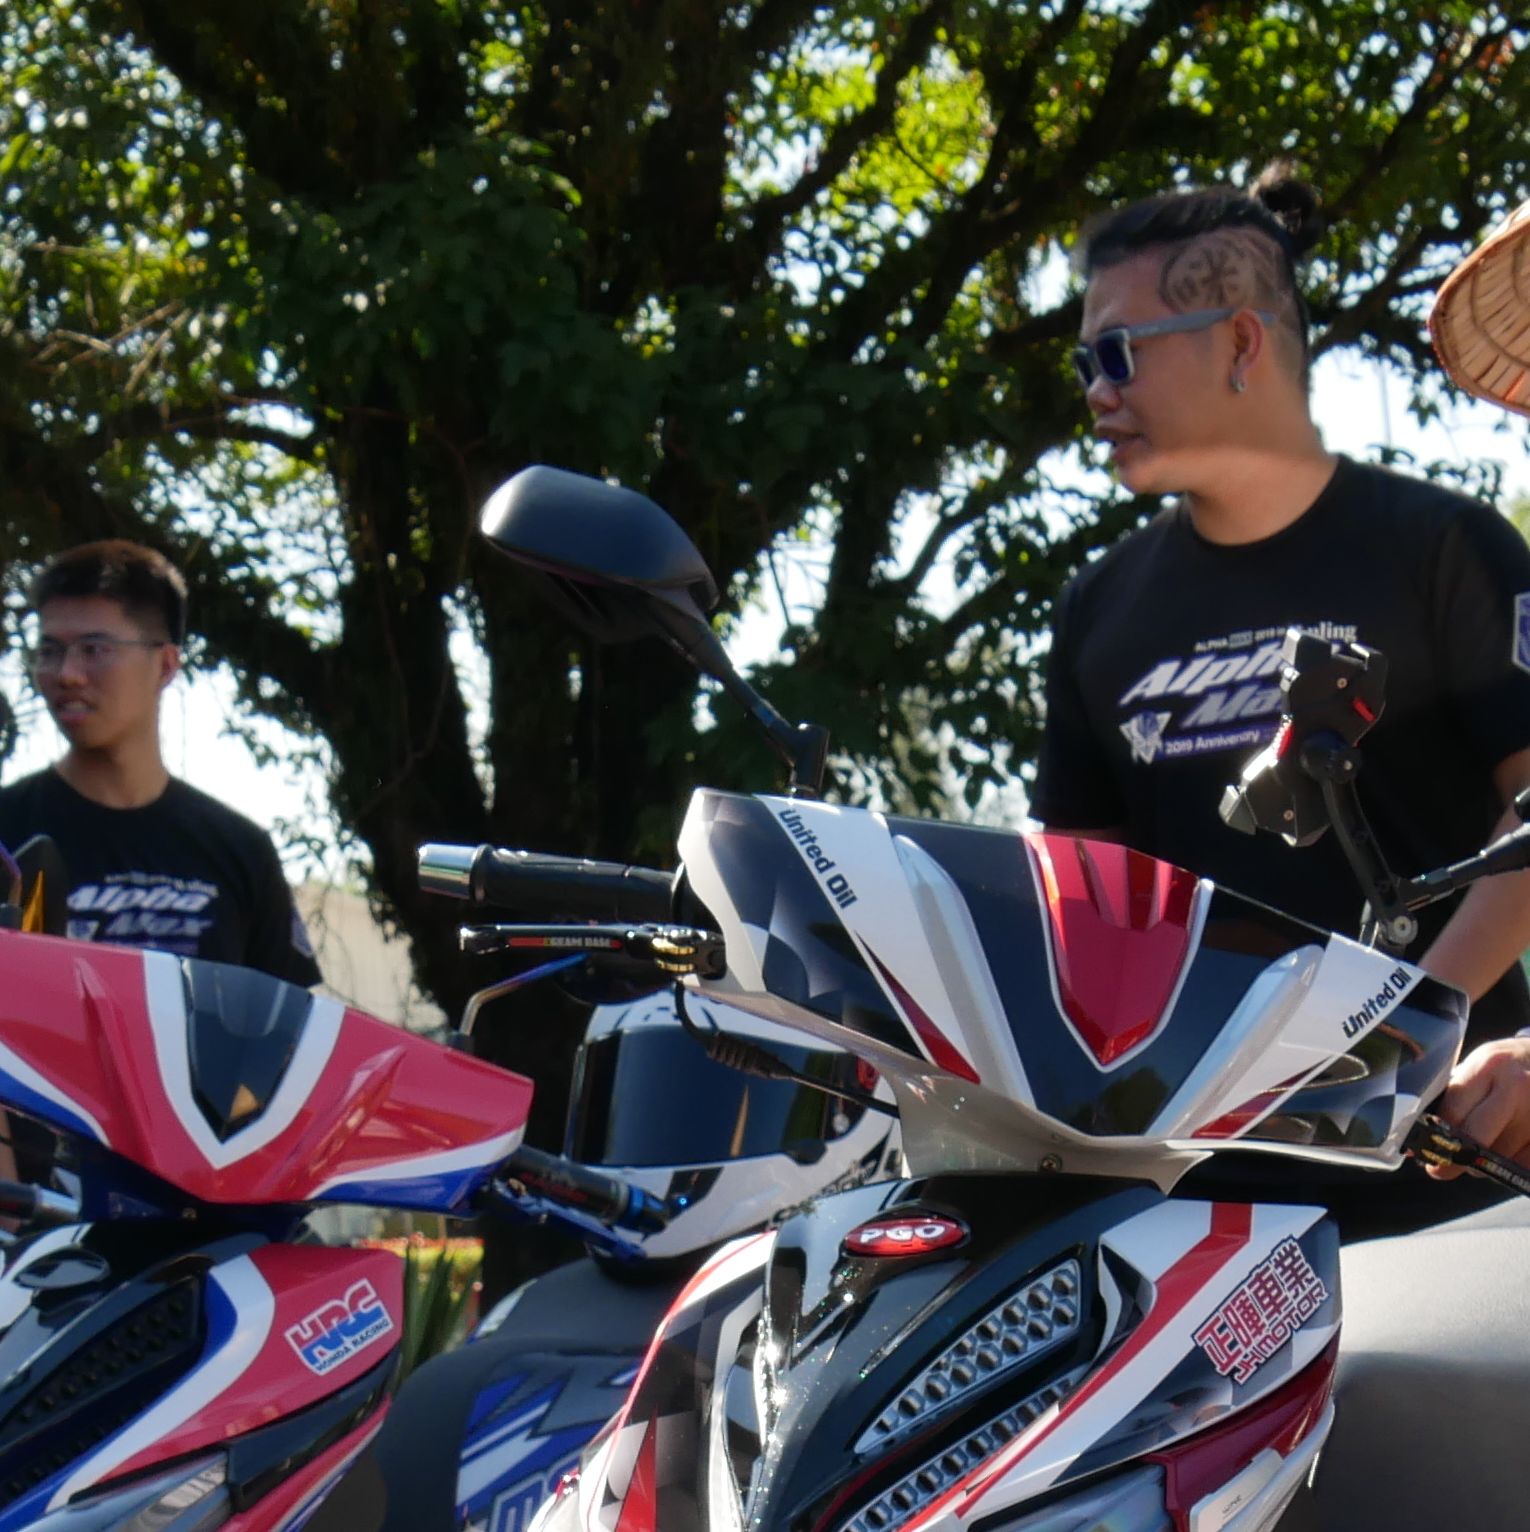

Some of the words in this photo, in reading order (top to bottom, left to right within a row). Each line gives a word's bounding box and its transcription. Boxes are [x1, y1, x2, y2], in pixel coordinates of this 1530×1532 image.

[1119, 640, 1289, 708] Alph
[1181, 684, 1285, 729] Ma
[777, 807, 837, 875] United
[825, 873, 859, 910] Oil
[1341, 981, 1398, 1039] United
[1389, 965, 1413, 991] Oil
[859, 1223, 946, 1244] PGO
[285, 1279, 387, 1368] HRC
